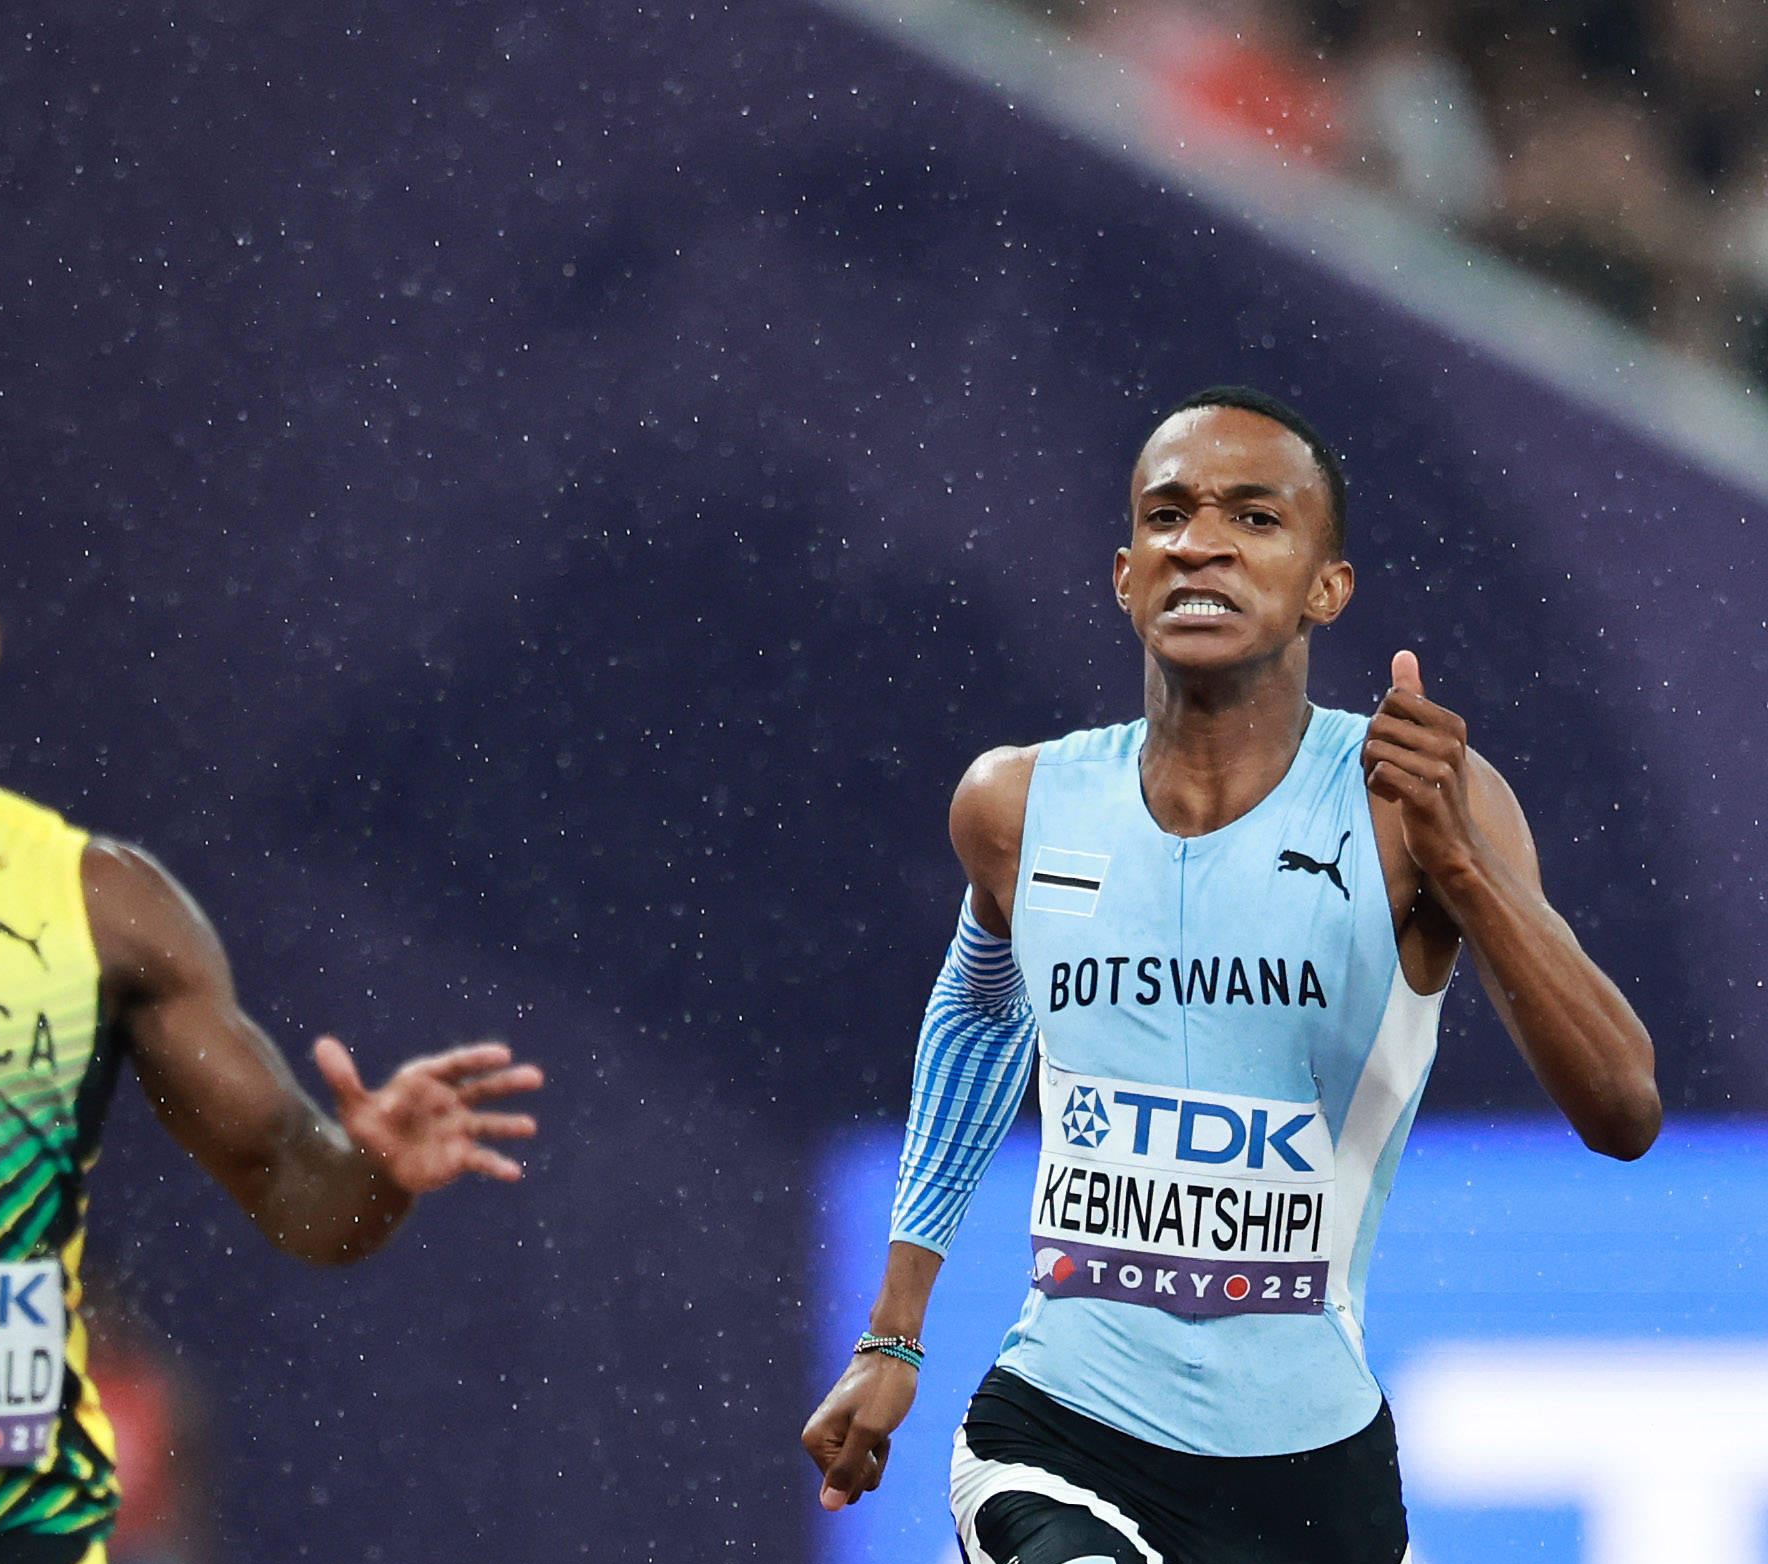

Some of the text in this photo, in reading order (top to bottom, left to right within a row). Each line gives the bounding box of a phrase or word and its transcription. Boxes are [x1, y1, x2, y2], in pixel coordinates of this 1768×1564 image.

[1049, 956, 1328, 1012] BOTSWANA
[1113, 1090, 1316, 1172] TDK
[1038, 1163, 1324, 1254] KEBINATSHIPI
